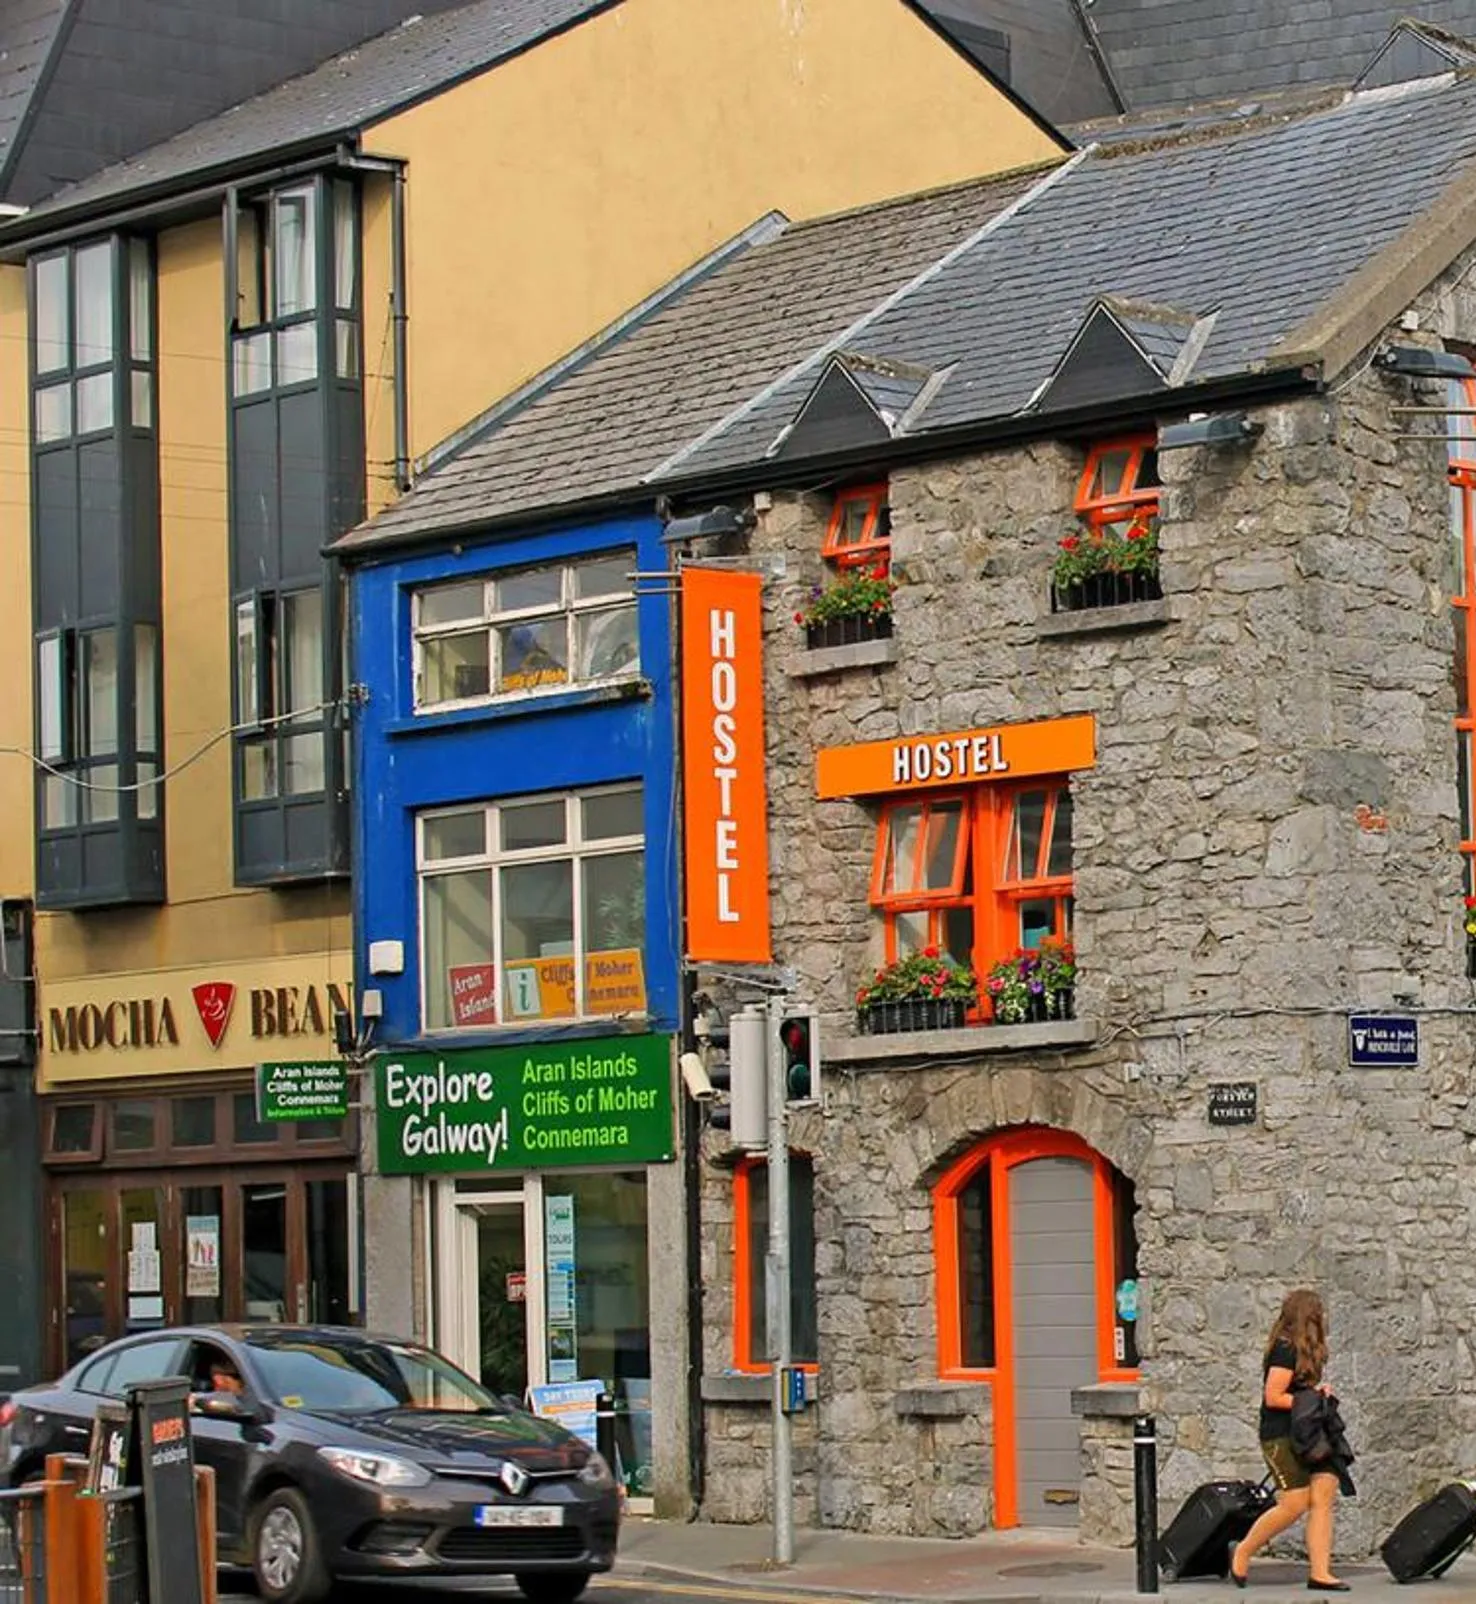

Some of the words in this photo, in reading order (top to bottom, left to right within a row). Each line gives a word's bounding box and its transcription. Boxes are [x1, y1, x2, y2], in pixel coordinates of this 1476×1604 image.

[709, 609, 740, 923] HOSTEL
[892, 734, 1009, 783] HOSTEL
[49, 996, 180, 1053] MOCHA
[273, 1066, 301, 1079] Aran
[303, 1065, 340, 1077] Islands
[522, 1059, 566, 1084] Aran
[571, 1052, 637, 1079] Islands
[267, 1081, 298, 1093] Cliffs
[277, 1094, 339, 1106] Connemara
[386, 1061, 494, 1116] Explore
[522, 1091, 570, 1117] Cliffs
[575, 1091, 593, 1113] of
[599, 1086, 658, 1112] Moher
[402, 1107, 509, 1165] Galway!
[523, 1125, 628, 1149] Connemara
